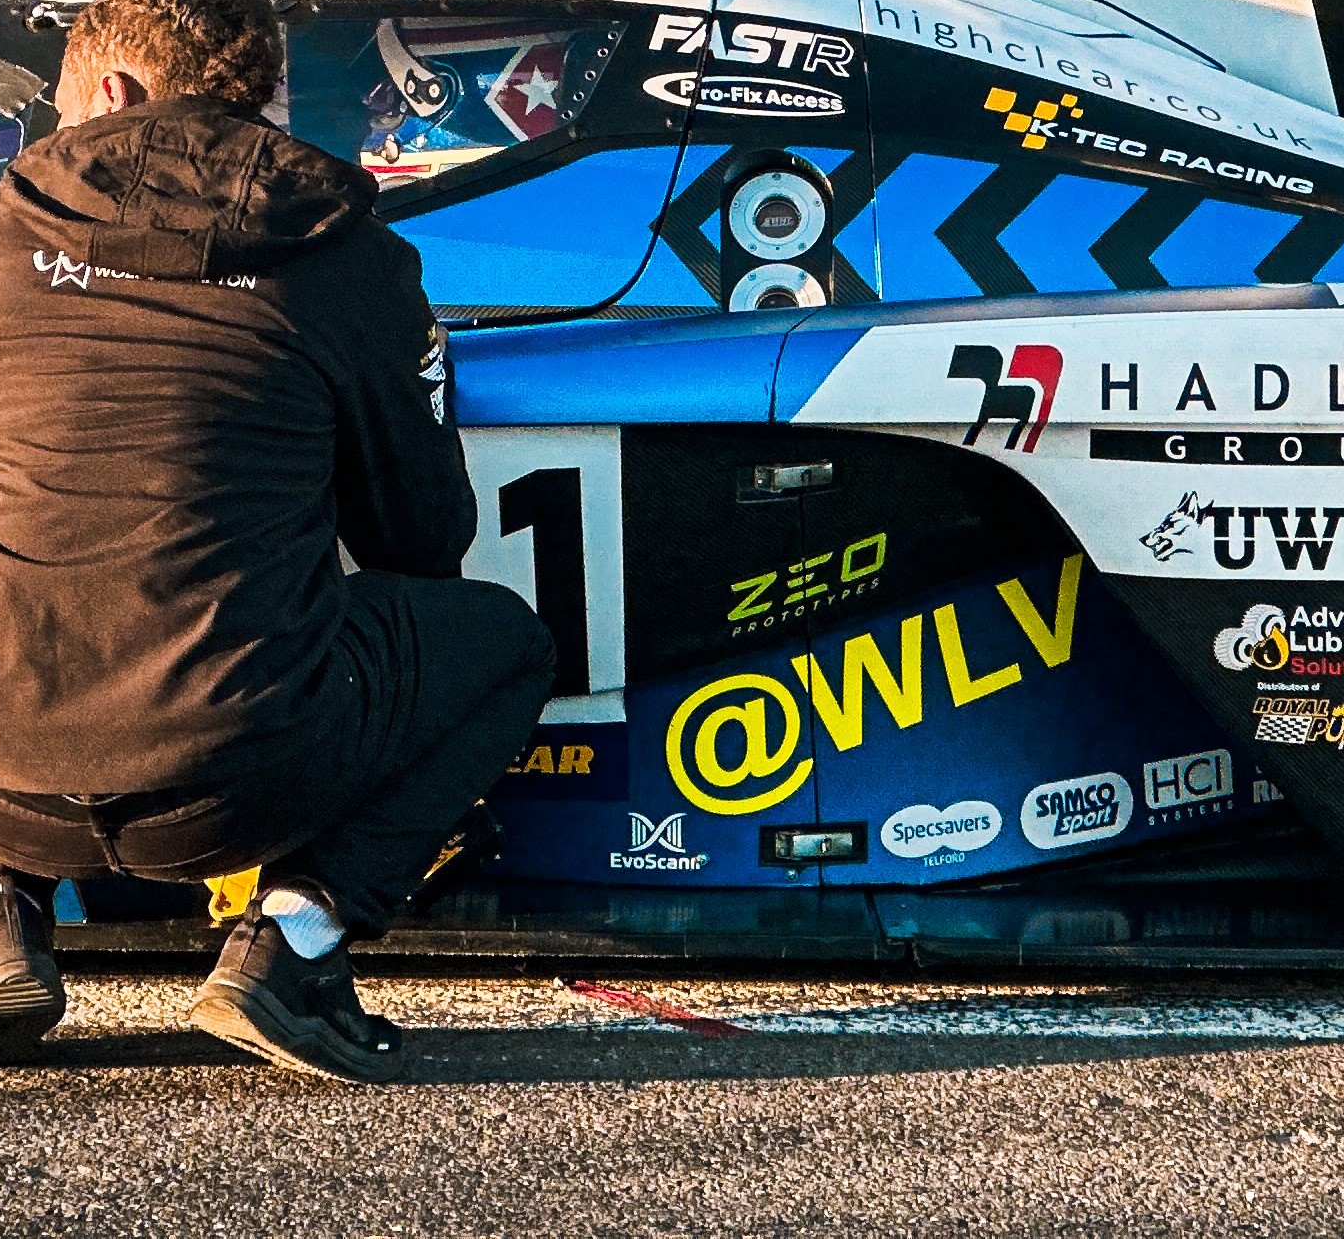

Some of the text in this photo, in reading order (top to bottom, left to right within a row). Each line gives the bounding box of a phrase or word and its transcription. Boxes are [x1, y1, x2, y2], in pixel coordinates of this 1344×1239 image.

[874, 0, 1313, 151] highclear.co.uk
[765, 88, 844, 112] Access
[1030, 118, 1315, 196] K-TEC RACING
[731, 576, 880, 637] PROTOTYPES
[1252, 697, 1330, 717] ROYAL
[1151, 755, 1223, 804] HCI
[1035, 781, 1117, 818] SAMCO
[1147, 799, 1235, 827] SYSTEMS
[892, 815, 991, 845] Specsavers
[1059, 803, 1113, 836] sport
[923, 852, 966, 868] TELFORD
